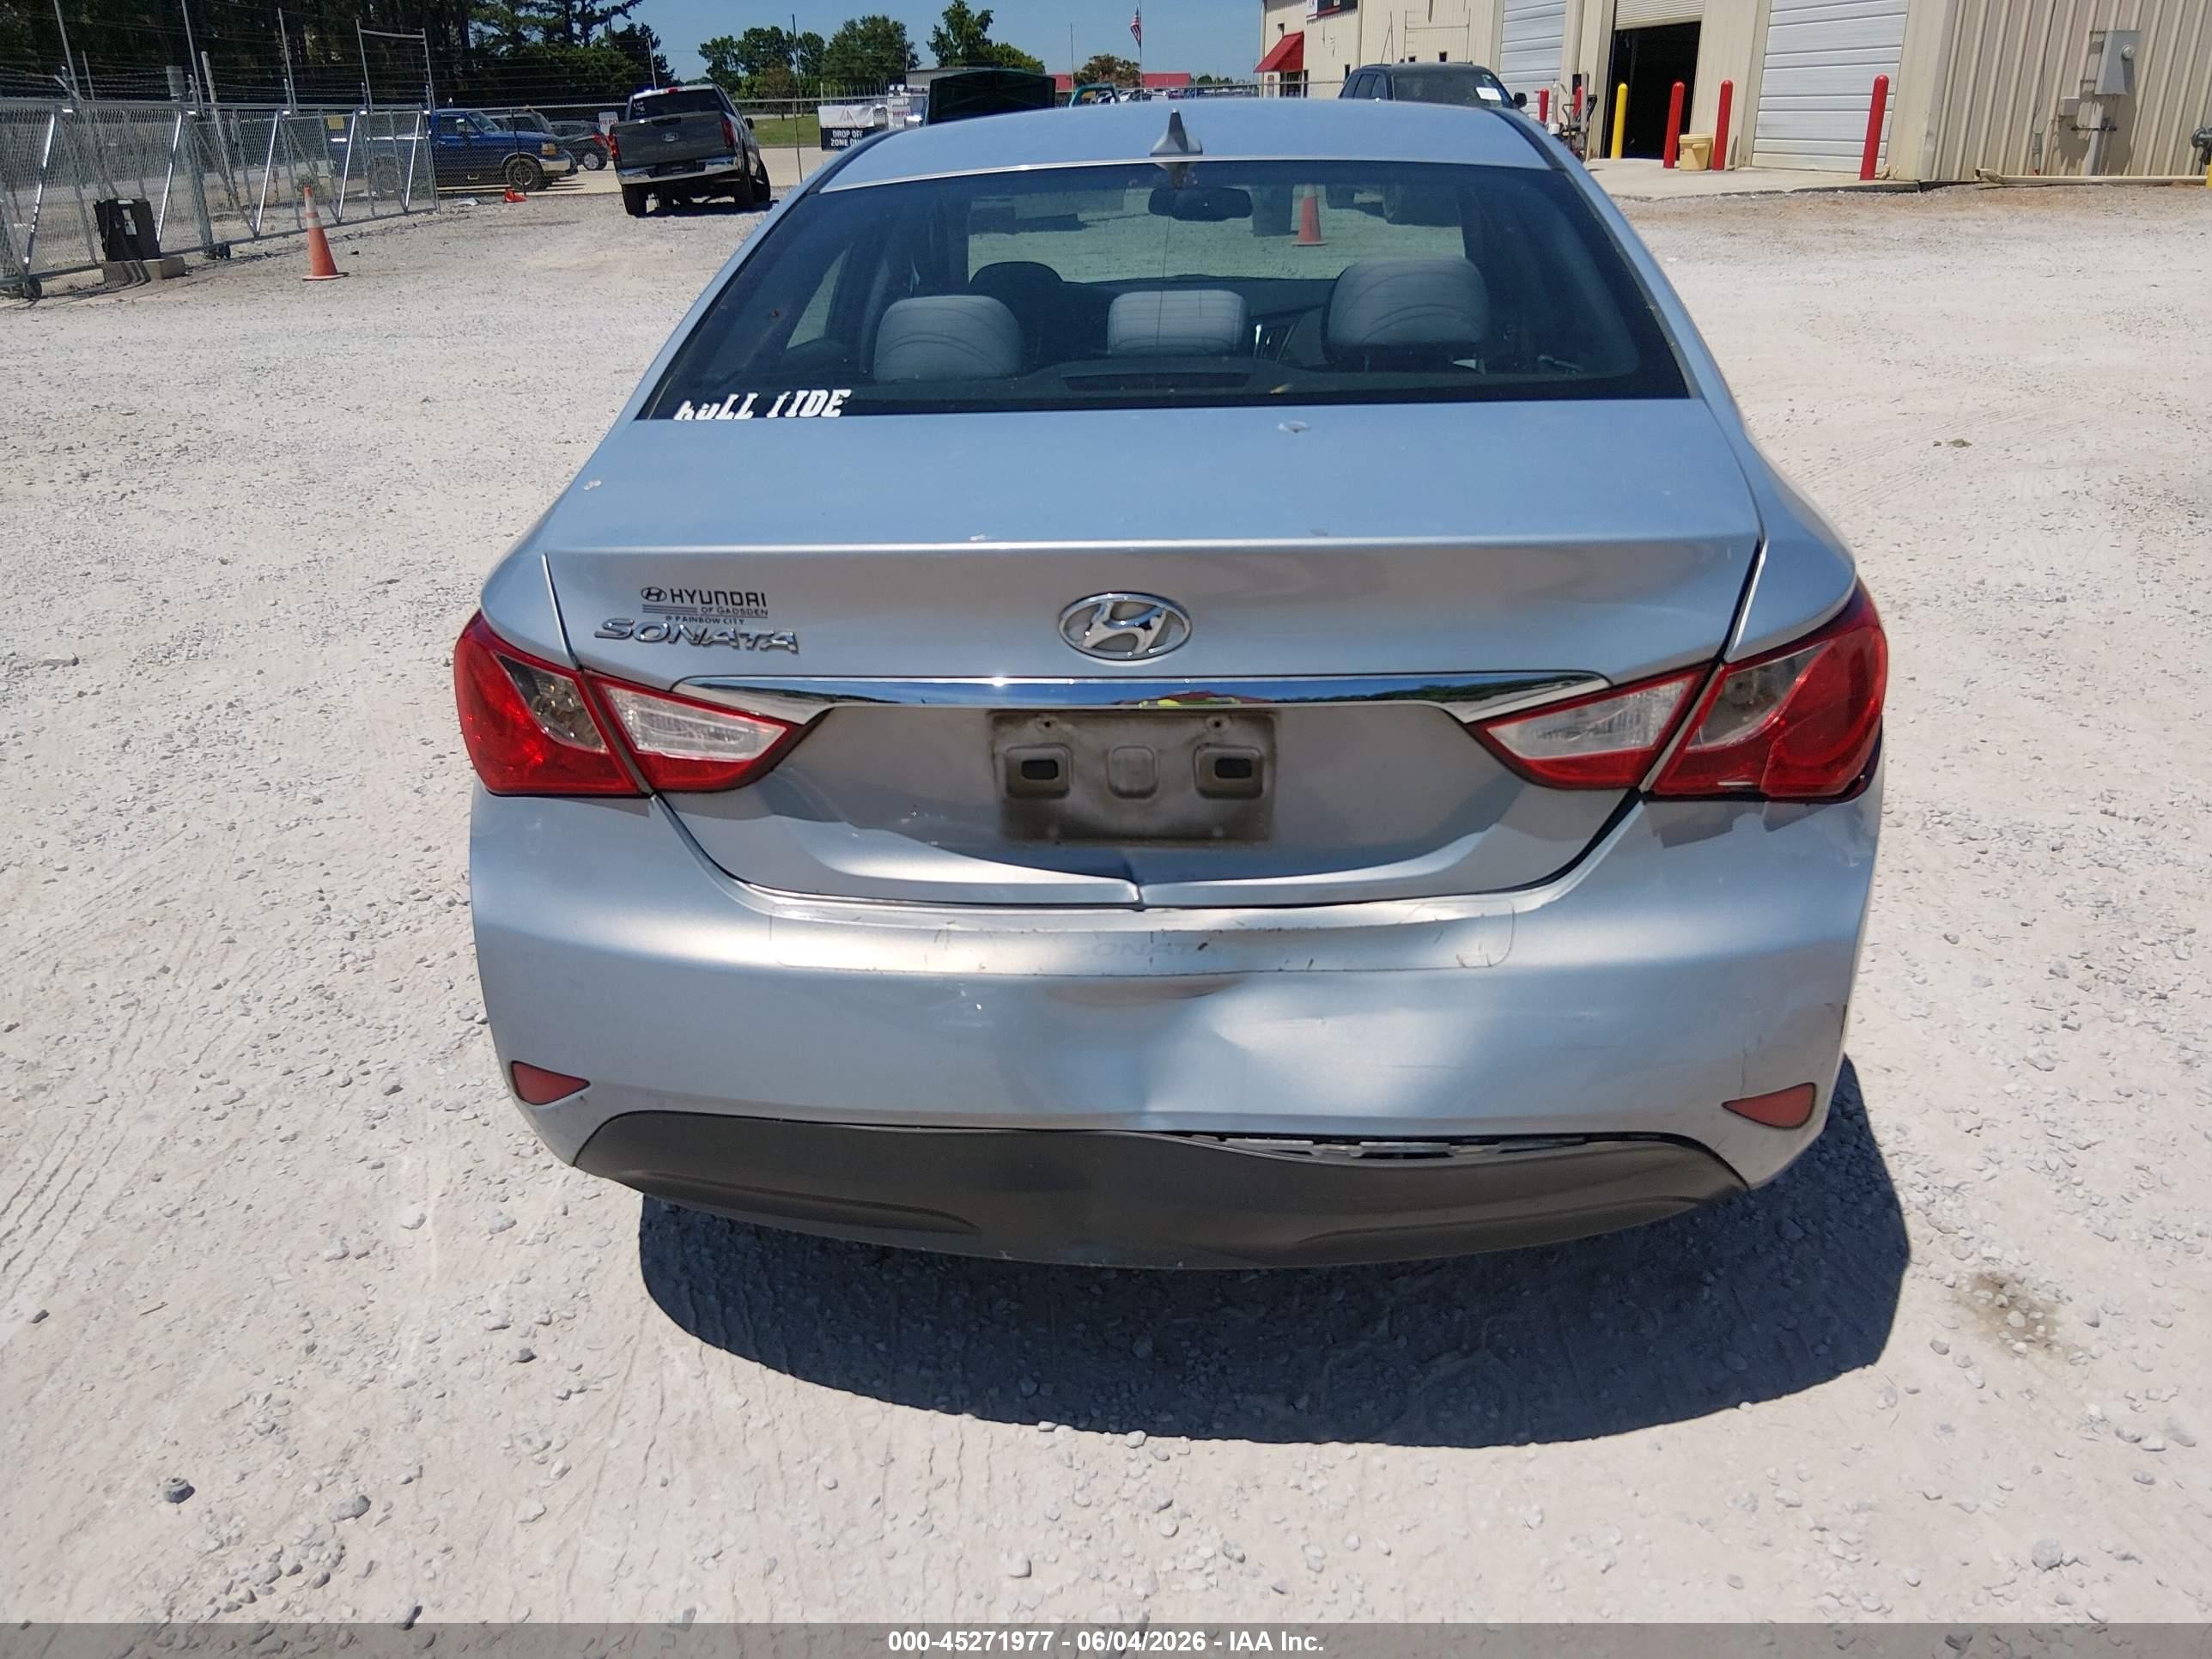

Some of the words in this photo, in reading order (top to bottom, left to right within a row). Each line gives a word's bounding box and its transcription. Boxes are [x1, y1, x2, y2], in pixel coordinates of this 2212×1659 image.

[830, 137, 848, 147] ZONE
[670, 588, 767, 608] HYUNDAI
[701, 606, 714, 615] OF
[716, 606, 769, 617] GADSDEN
[723, 617, 745, 626] CITY
[594, 617, 799, 655] SONATA
